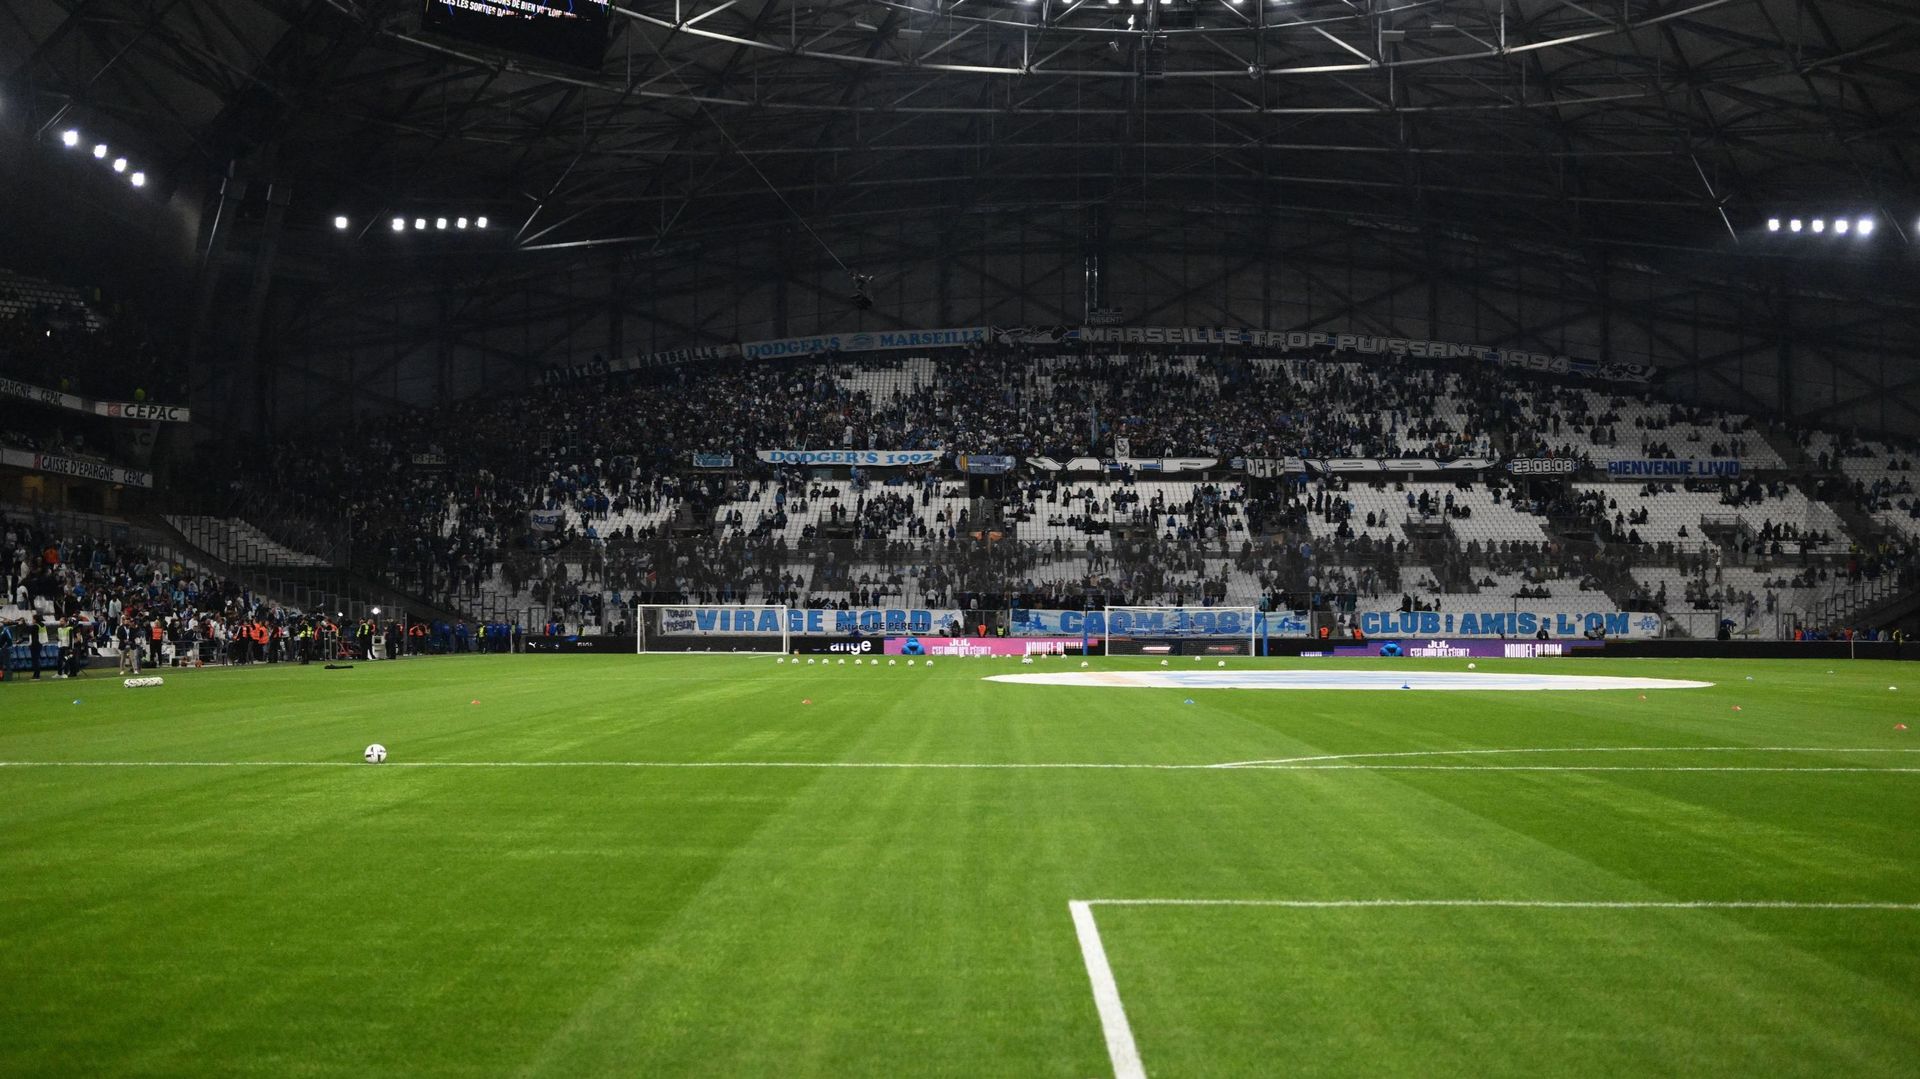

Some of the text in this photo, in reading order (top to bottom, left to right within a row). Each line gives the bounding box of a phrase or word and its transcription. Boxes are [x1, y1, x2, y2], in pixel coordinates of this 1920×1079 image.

[456, 0, 469, 9] LES
[469, 1, 496, 15] SORTIES
[521, 1, 536, 12] BIEN
[746, 329, 985, 357] DODGER'S MARSEILLE
[1079, 327, 1571, 374] MARSEILLE TROP PUISSANT 1994
[124, 404, 179, 421] CEPAC
[770, 451, 934, 464] DODGER'S 1992
[41, 455, 145, 486] CAISSE D'EPARGNE CEPAC
[1512, 459, 1575, 474] 23.08.08
[1608, 460, 1693, 476] BIENVENUE
[695, 609, 931, 633] VIRAGE NORD
[872, 622, 886, 630] DE
[888, 622, 930, 631] PERETTI
[1060, 612, 1165, 635] CAOM
[1361, 612, 1441, 634] CLUB
[1459, 612, 1538, 635] AMIS
[1557, 612, 1630, 635] L'OM
[1428, 640, 1449, 648] JUL
